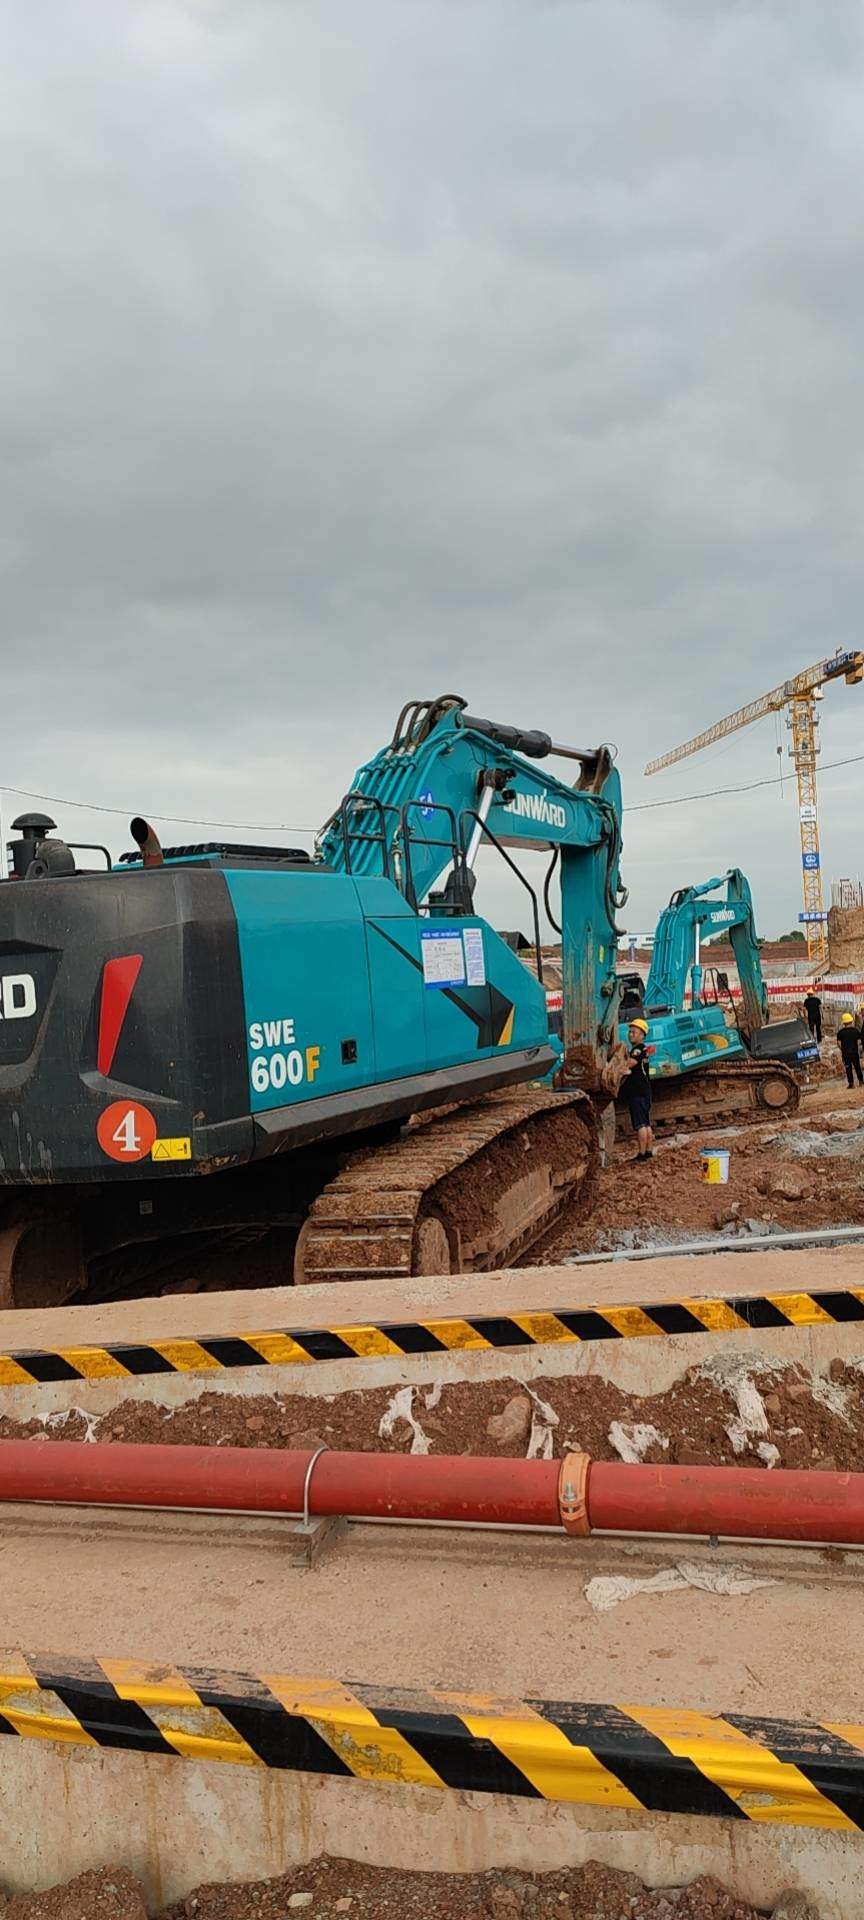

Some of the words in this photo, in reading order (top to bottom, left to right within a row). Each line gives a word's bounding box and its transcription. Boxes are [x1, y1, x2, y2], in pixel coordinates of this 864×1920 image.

[249, 1018, 296, 1050] SWE
[251, 1046, 320, 1093] 600F
[112, 1109, 141, 1152] 4
